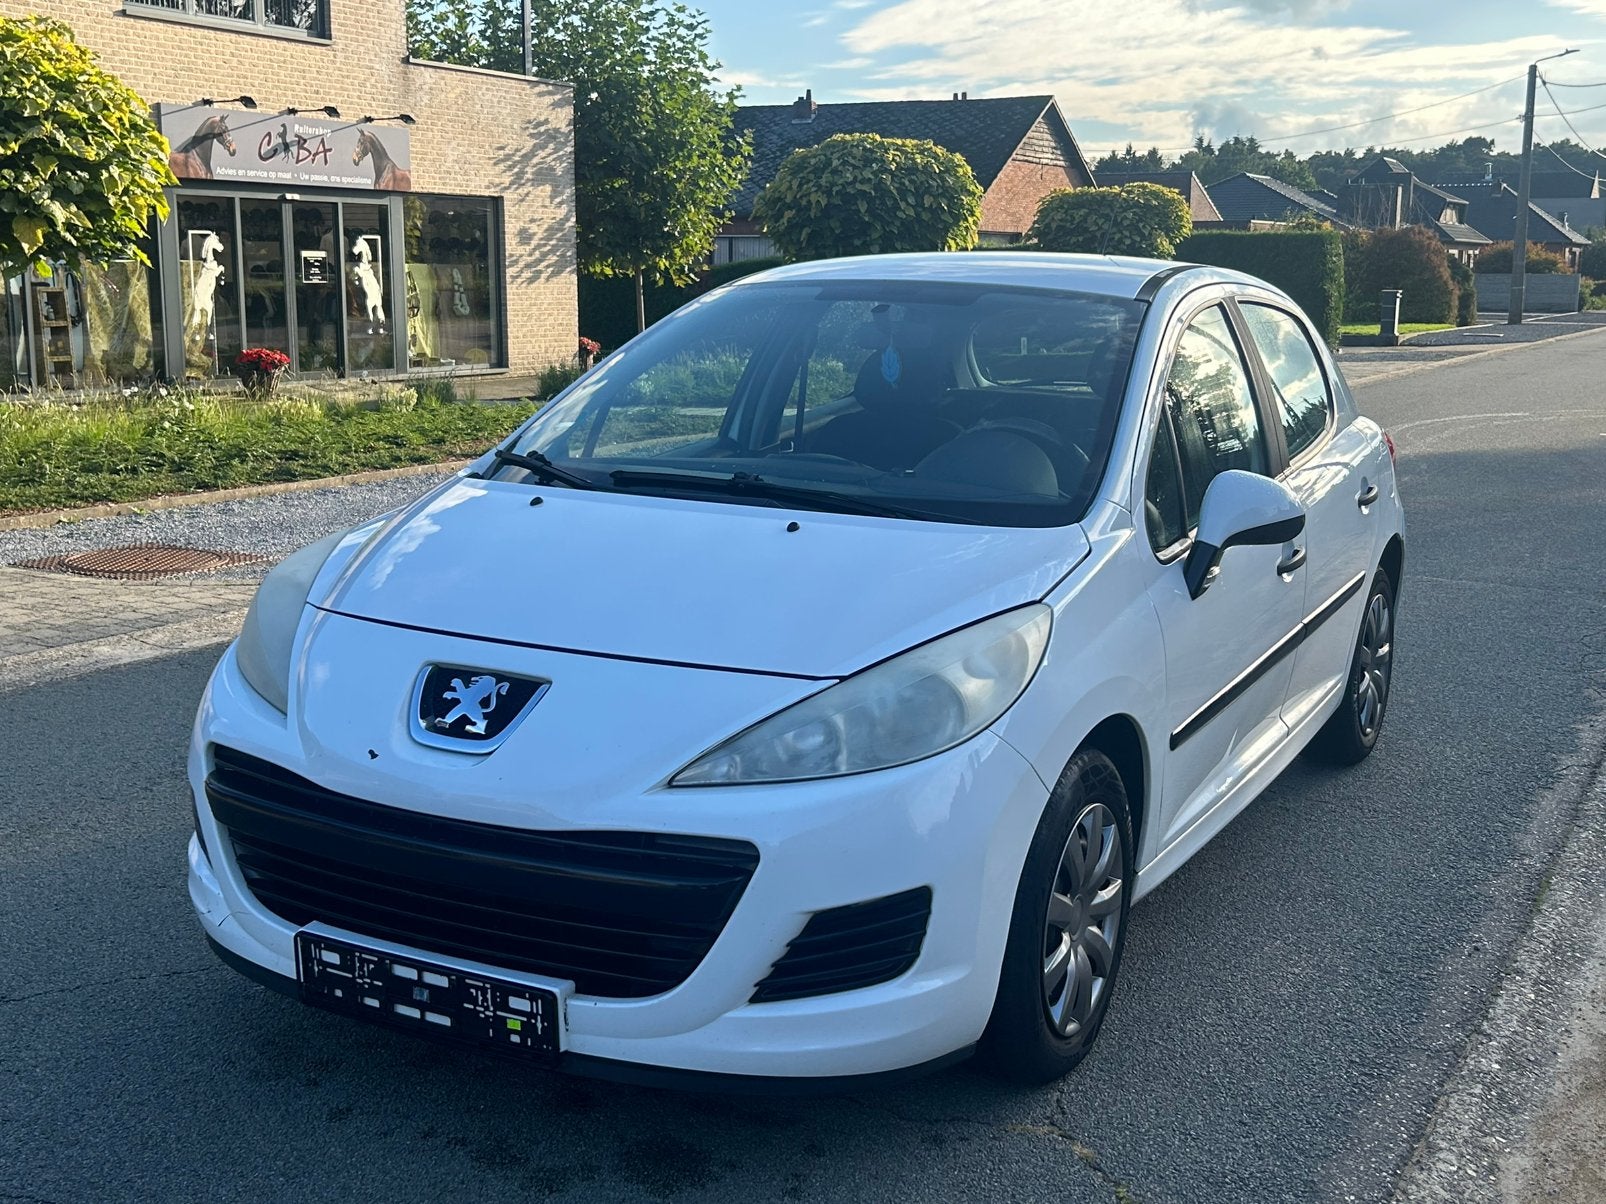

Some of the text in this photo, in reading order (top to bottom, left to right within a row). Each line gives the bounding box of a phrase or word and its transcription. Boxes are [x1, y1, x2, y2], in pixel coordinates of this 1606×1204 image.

[216, 166, 237, 176] Advies
[247, 169, 267, 178] service
[268, 171, 277, 180] op
[300, 172, 309, 180] Uw
